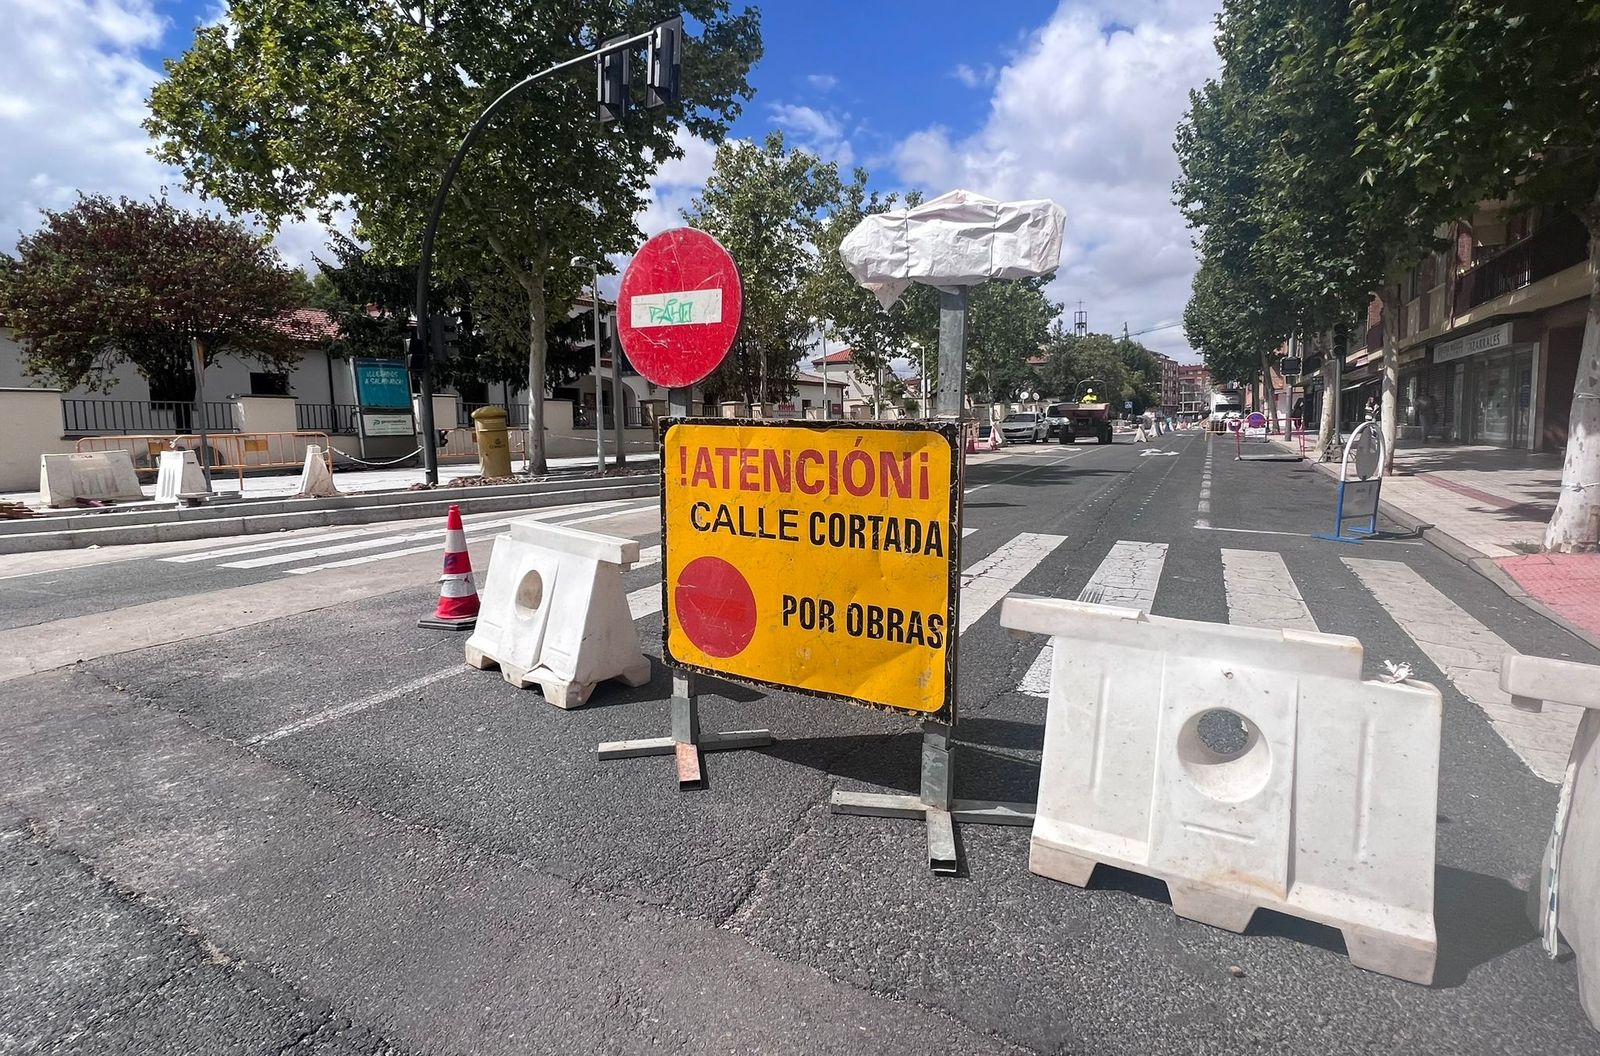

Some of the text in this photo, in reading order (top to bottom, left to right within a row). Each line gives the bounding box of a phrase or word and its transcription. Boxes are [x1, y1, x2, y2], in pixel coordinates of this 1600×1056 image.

[690, 501, 944, 558] CALLE CORTADA
[782, 594, 944, 649] POR OBRAS
